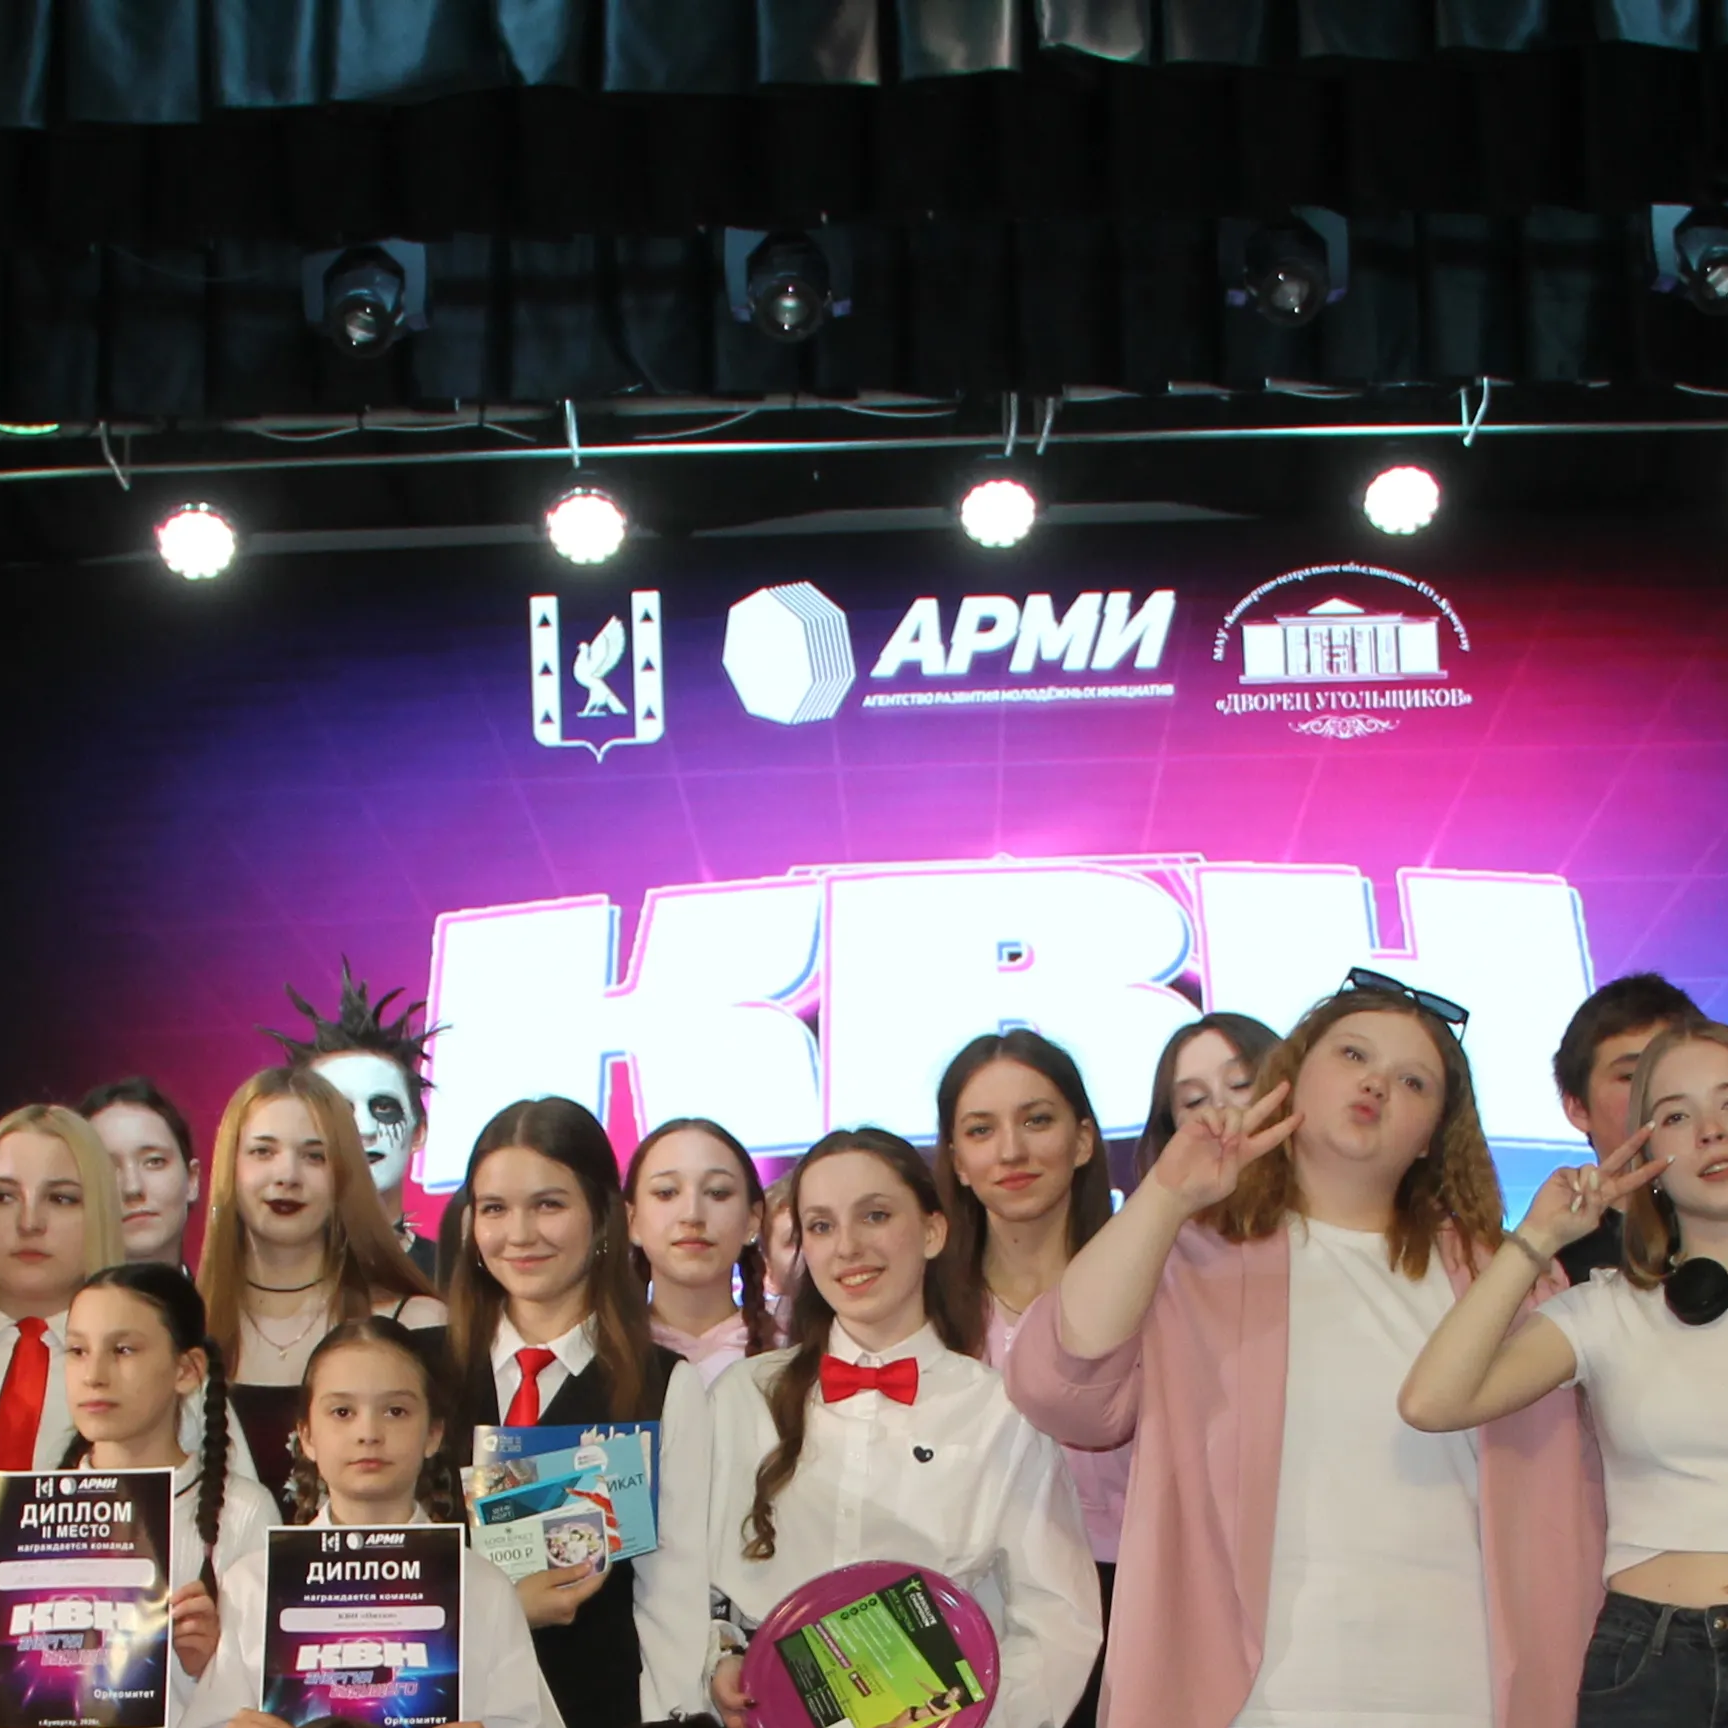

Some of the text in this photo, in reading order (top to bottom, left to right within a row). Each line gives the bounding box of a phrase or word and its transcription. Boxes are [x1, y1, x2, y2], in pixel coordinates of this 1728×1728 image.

[870, 590, 1176, 678] АРМИ
[862, 691, 933, 707] АГЕНТСТВО
[935, 688, 1000, 705] РАЗВИТИЯ
[1215, 688, 1473, 715] «ДВОРЕЦ УГОЛЬЩИКОВ»
[415, 862, 1597, 1192] КВН
[78, 1477, 118, 1490] АРМИ
[606, 1473, 644, 1492] ИКАТ
[20, 1501, 132, 1528] ДИПЛОМ
[42, 1524, 110, 1538] II МЕСТО
[365, 1533, 405, 1545] АРМИ
[17, 1542, 134, 1553] награждается команда
[490, 1548, 521, 1562] 1000
[306, 1561, 421, 1584] ДИПЛОМ
[303, 1592, 423, 1603] награждается команда
[9, 1603, 138, 1635] КВН
[296, 1643, 428, 1671] КВН
[384, 1716, 447, 1726] Оргкомитет
